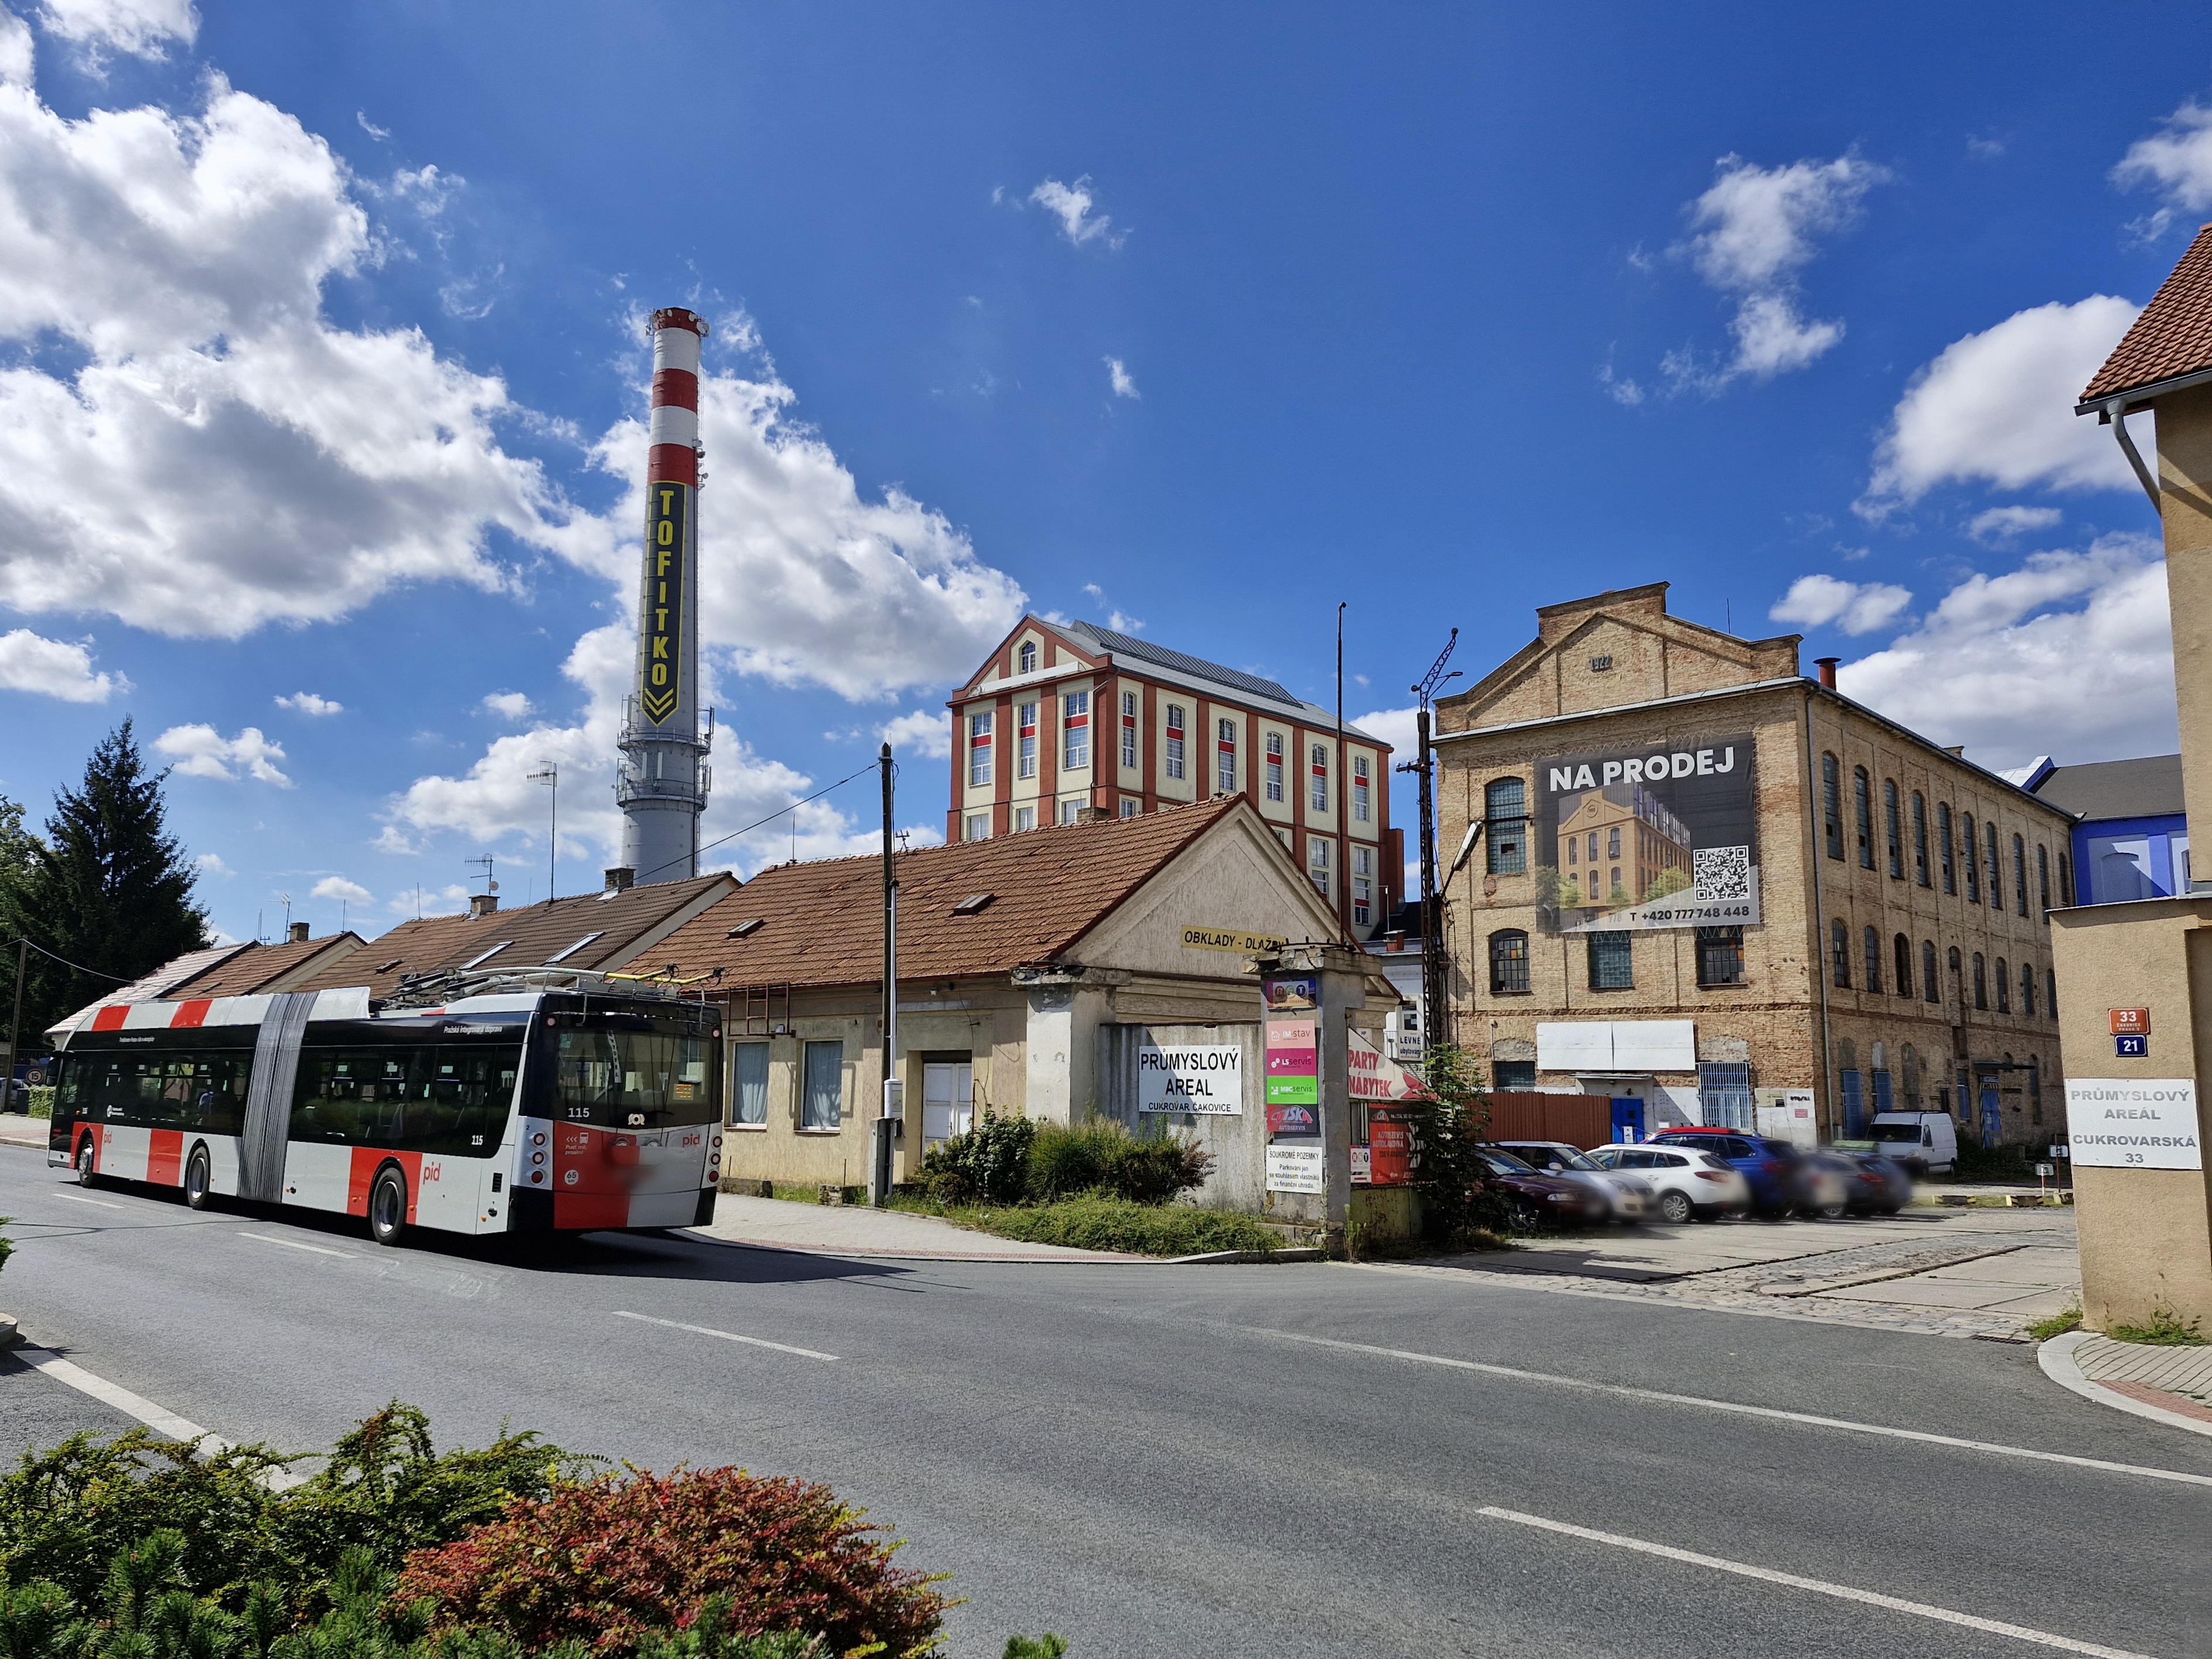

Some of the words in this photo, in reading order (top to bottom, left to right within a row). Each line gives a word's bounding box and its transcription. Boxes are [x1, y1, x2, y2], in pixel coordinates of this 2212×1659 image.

[651, 490, 675, 686] TOFITKO
[1549, 764, 1596, 791] NA
[1603, 746, 1734, 786] PRODEJ
[1630, 912, 1637, 921] T
[1641, 910, 1672, 921] +420
[1675, 909, 1694, 919] 777
[1698, 907, 1721, 918] 748
[1723, 906, 1750, 917] 448
[1184, 930, 1236, 947] OBKLADY
[2119, 1011, 2137, 1022] 33
[2123, 1040, 2138, 1052] 21
[1141, 1047, 1238, 1070] PRŮMYSLOVÝ
[1348, 1049, 1380, 1070] PARTY
[1165, 1078, 1213, 1096] AREAL
[1348, 1071, 1392, 1097] NÁBYTEK
[2071, 1087, 2190, 1102] PRŮMYSLOVÝ
[568, 1107, 590, 1118] 115
[1148, 1102, 1190, 1111] CUKROVAR
[1193, 1101, 1231, 1112] ČAKOVICE
[2104, 1107, 2162, 1120] AREÁL
[471, 1135, 483, 1146] 115
[682, 1133, 700, 1148] pid
[2073, 1135, 2197, 1148] CUKROVARSKÁ
[1269, 1149, 1296, 1159] SOUKROMÉ
[1296, 1152, 1319, 1160] POZEMKY
[2125, 1153, 2144, 1163] 33
[423, 1161, 441, 1185] pid
